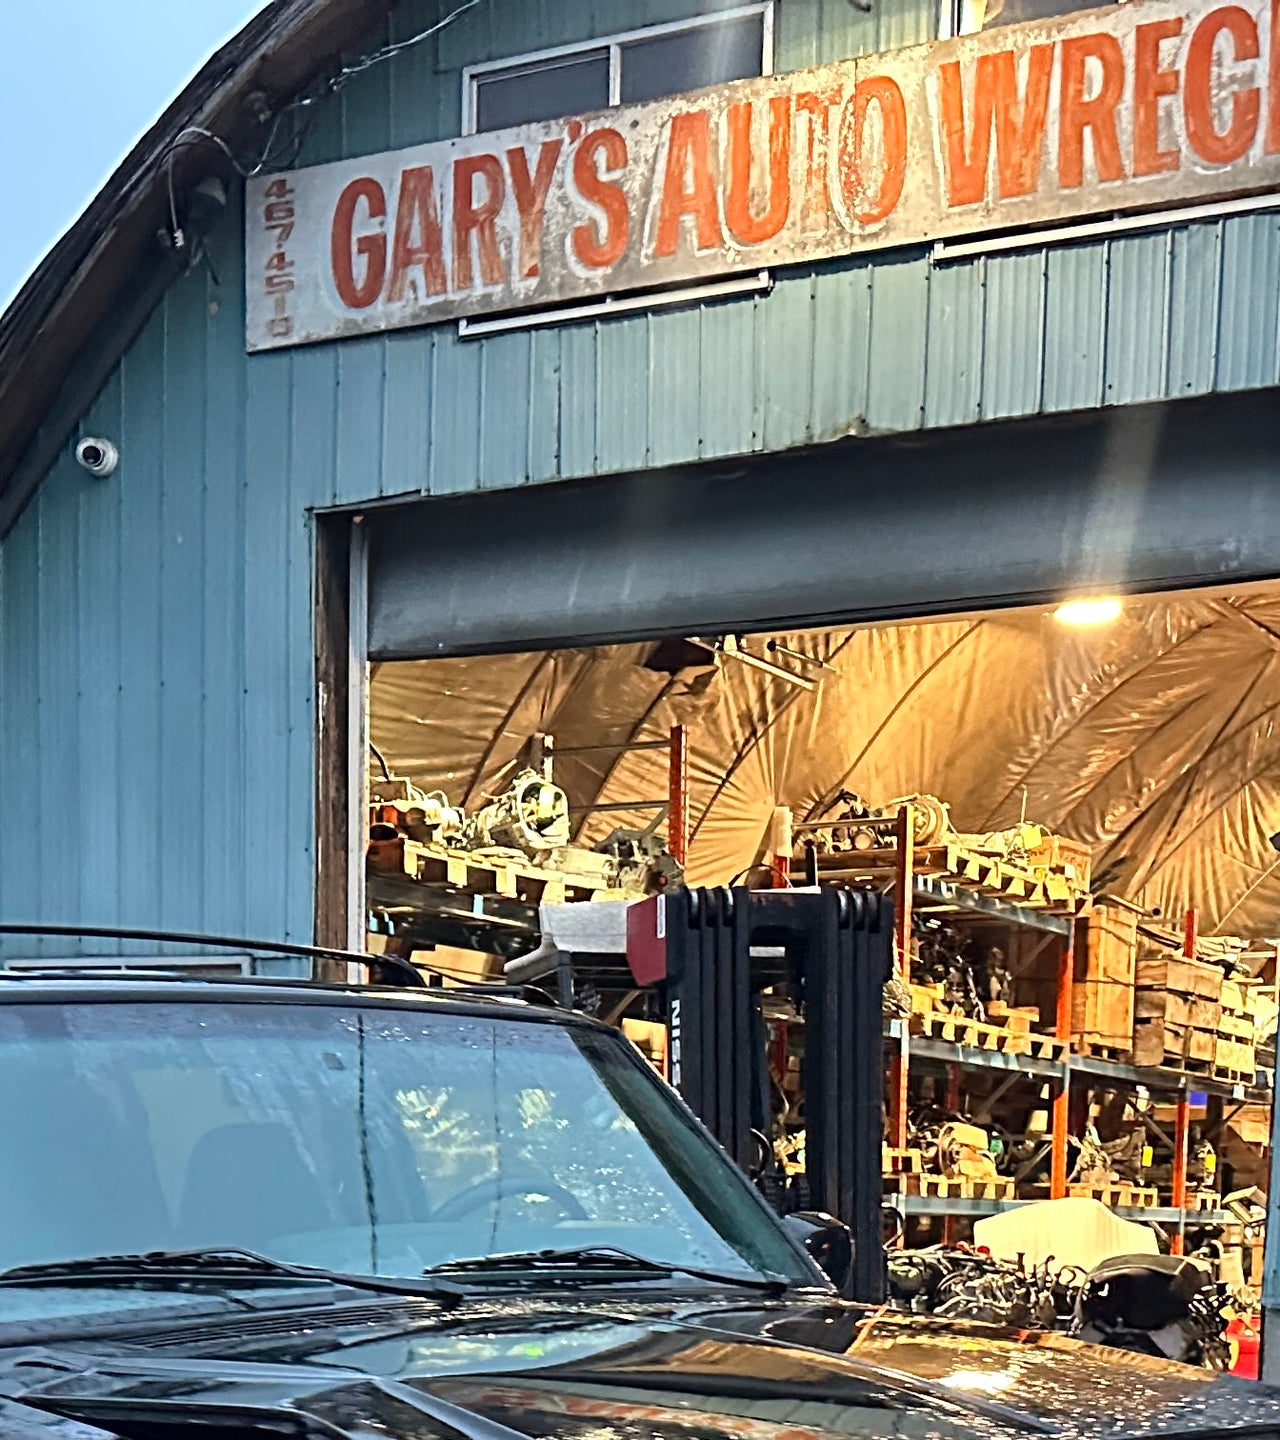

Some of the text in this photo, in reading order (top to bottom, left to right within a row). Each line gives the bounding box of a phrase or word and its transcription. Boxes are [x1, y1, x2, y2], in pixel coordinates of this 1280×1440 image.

[331, 121, 629, 309] GARY'S
[654, 75, 908, 258] AUTO
[671, 999, 681, 1087] NISS
